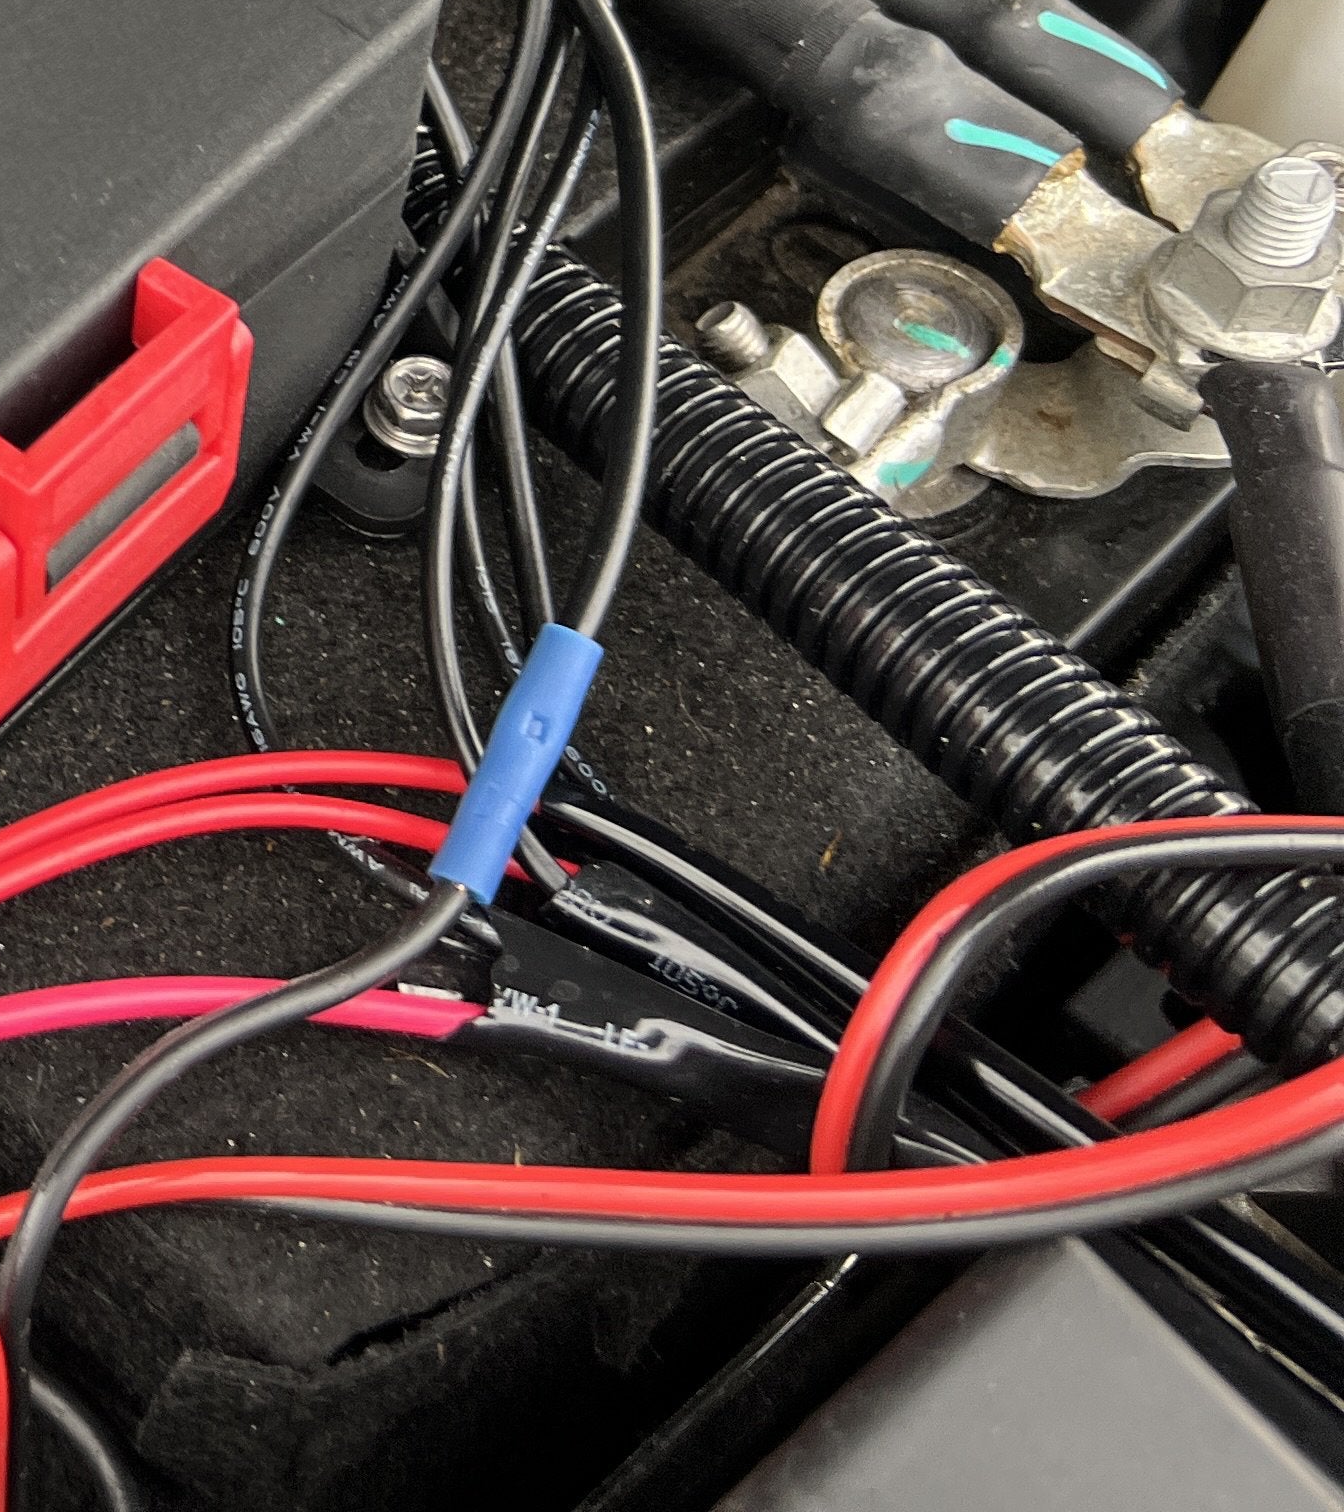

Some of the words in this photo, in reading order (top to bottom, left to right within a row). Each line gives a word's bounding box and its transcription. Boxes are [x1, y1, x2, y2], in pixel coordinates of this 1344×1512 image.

[247, 485, 281, 557] 600V
[287, 404, 327, 461] VW-1
[564, 744, 615, 804] 600
